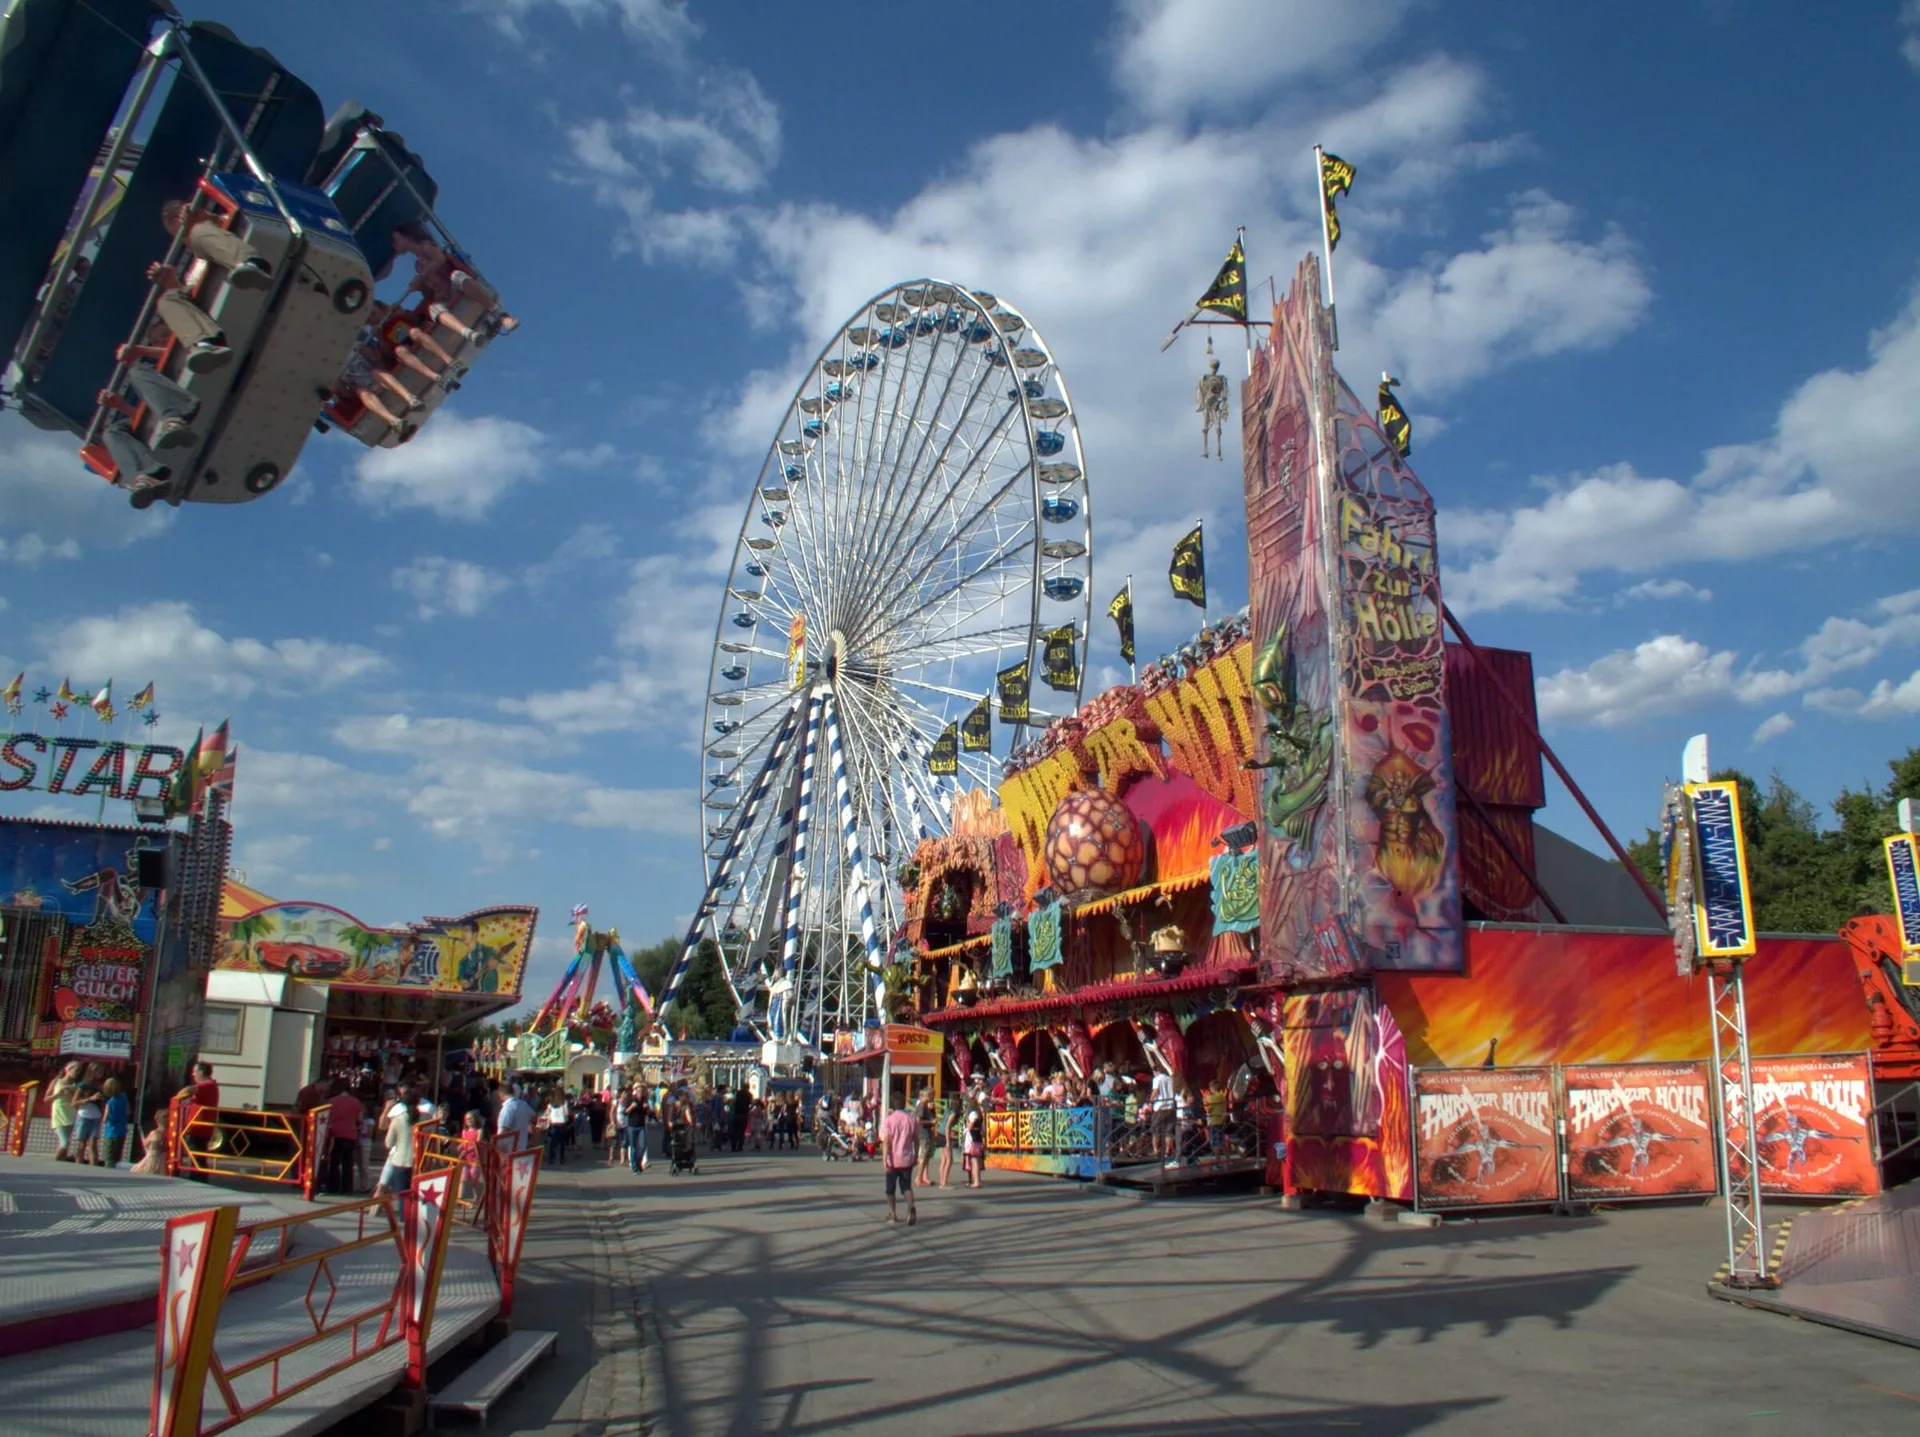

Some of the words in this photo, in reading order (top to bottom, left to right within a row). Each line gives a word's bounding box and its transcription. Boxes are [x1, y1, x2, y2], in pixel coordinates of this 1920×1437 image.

[1341, 494, 1434, 574] Fahrt
[1373, 568, 1410, 597] zur
[1353, 596, 1438, 642] Hölle
[0, 733, 185, 800] STAR
[73, 981, 135, 1000] GULCH
[1501, 1085, 1552, 1137] HÖLLE
[1654, 1079, 1708, 1130] HÖLLE
[1810, 1073, 1867, 1127] HÖLLE
